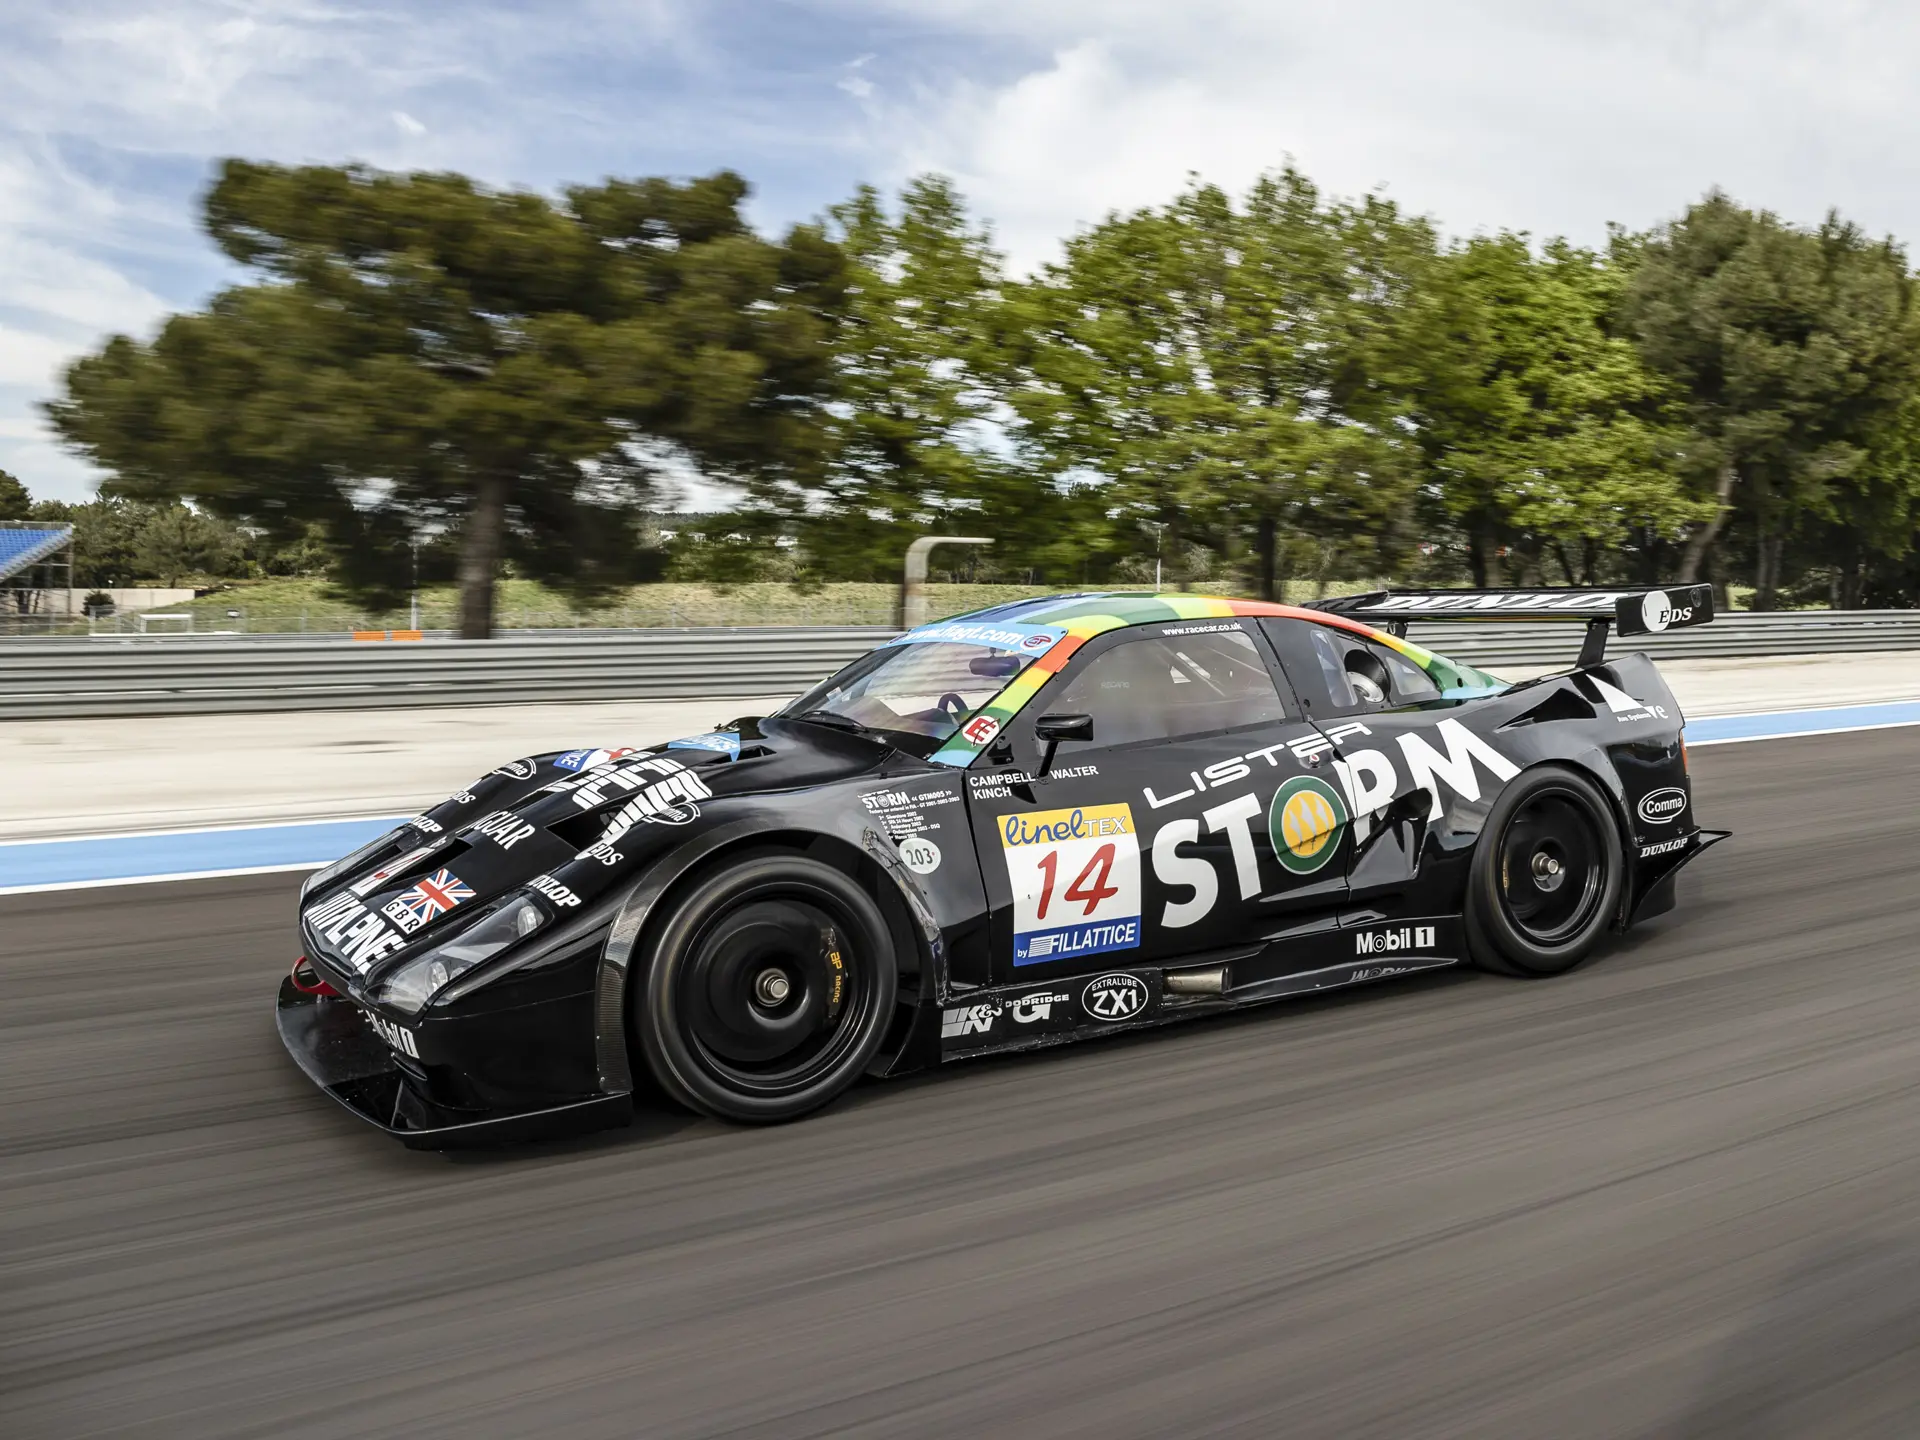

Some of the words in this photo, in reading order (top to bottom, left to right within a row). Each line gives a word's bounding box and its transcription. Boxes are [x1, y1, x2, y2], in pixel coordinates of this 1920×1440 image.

[1658, 607, 1692, 624] EDS
[1162, 622, 1242, 636] www.racecar.co.uk
[969, 771, 1036, 787] CAMPBELL
[1052, 765, 1099, 780] WALTER
[1143, 722, 1373, 809] LISTER
[862, 791, 911, 809] STORM
[973, 786, 1012, 800] KINCH
[1646, 797, 1683, 814] Comma
[1152, 718, 1522, 928] STORM
[588, 843, 624, 866] EDS
[906, 848, 933, 866] 203
[1640, 838, 1688, 858] DUNLOP
[1037, 843, 1118, 920] 14
[386, 902, 420, 932] GBR
[1017, 948, 1028, 959] by
[1049, 922, 1136, 953] FILLATTICE
[1356, 928, 1411, 954] Mobil
[1091, 977, 1138, 991] EXTRALUBE
[1092, 988, 1139, 1016] ZX1
